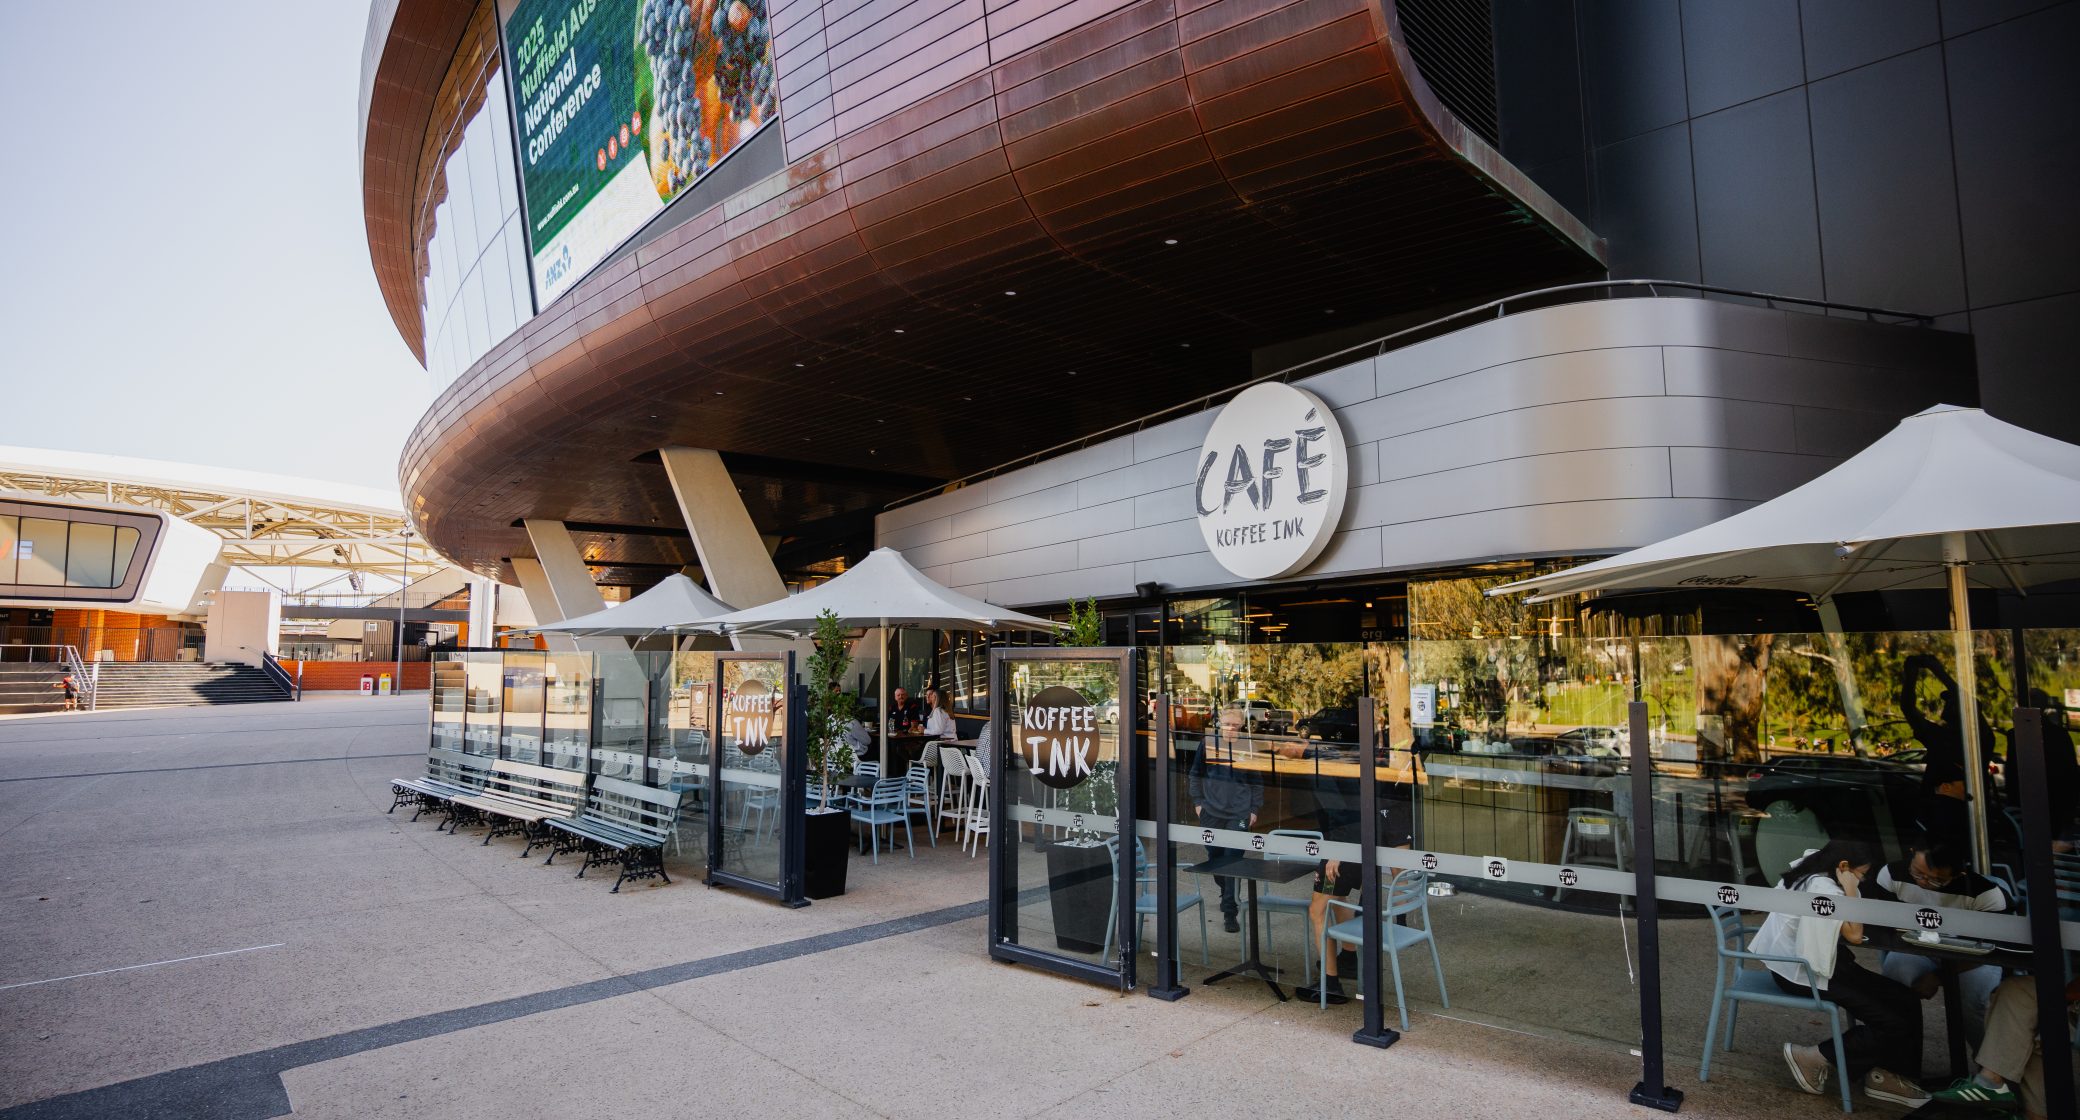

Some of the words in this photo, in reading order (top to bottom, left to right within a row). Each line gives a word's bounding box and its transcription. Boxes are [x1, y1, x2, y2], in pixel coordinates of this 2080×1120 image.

[518, 15, 545, 75] 2025
[520, 18, 568, 106] Nuffield
[570, 0, 600, 41] Aus
[524, 46, 577, 137] National
[528, 63, 601, 166] Conference
[1195, 407, 1329, 517] CAFÉ
[1216, 522, 1267, 548] KOFFEE
[1272, 516, 1305, 541] INK
[732, 694, 772, 714] KOFFEE
[1024, 705, 1096, 732] KOFFEE
[733, 715, 769, 748] INK
[1026, 735, 1092, 778] INK
[1422, 861, 1437, 869] INK
[1489, 868, 1505, 877] INK
[1560, 876, 1577, 886] INK
[1718, 888, 1738, 896] KOFFEE
[1719, 894, 1737, 903] INK
[1812, 899, 1835, 907] KOFFEE
[1813, 905, 1834, 915] INK
[1916, 911, 1940, 919] KOFFEE
[1917, 917, 1940, 927] INK
